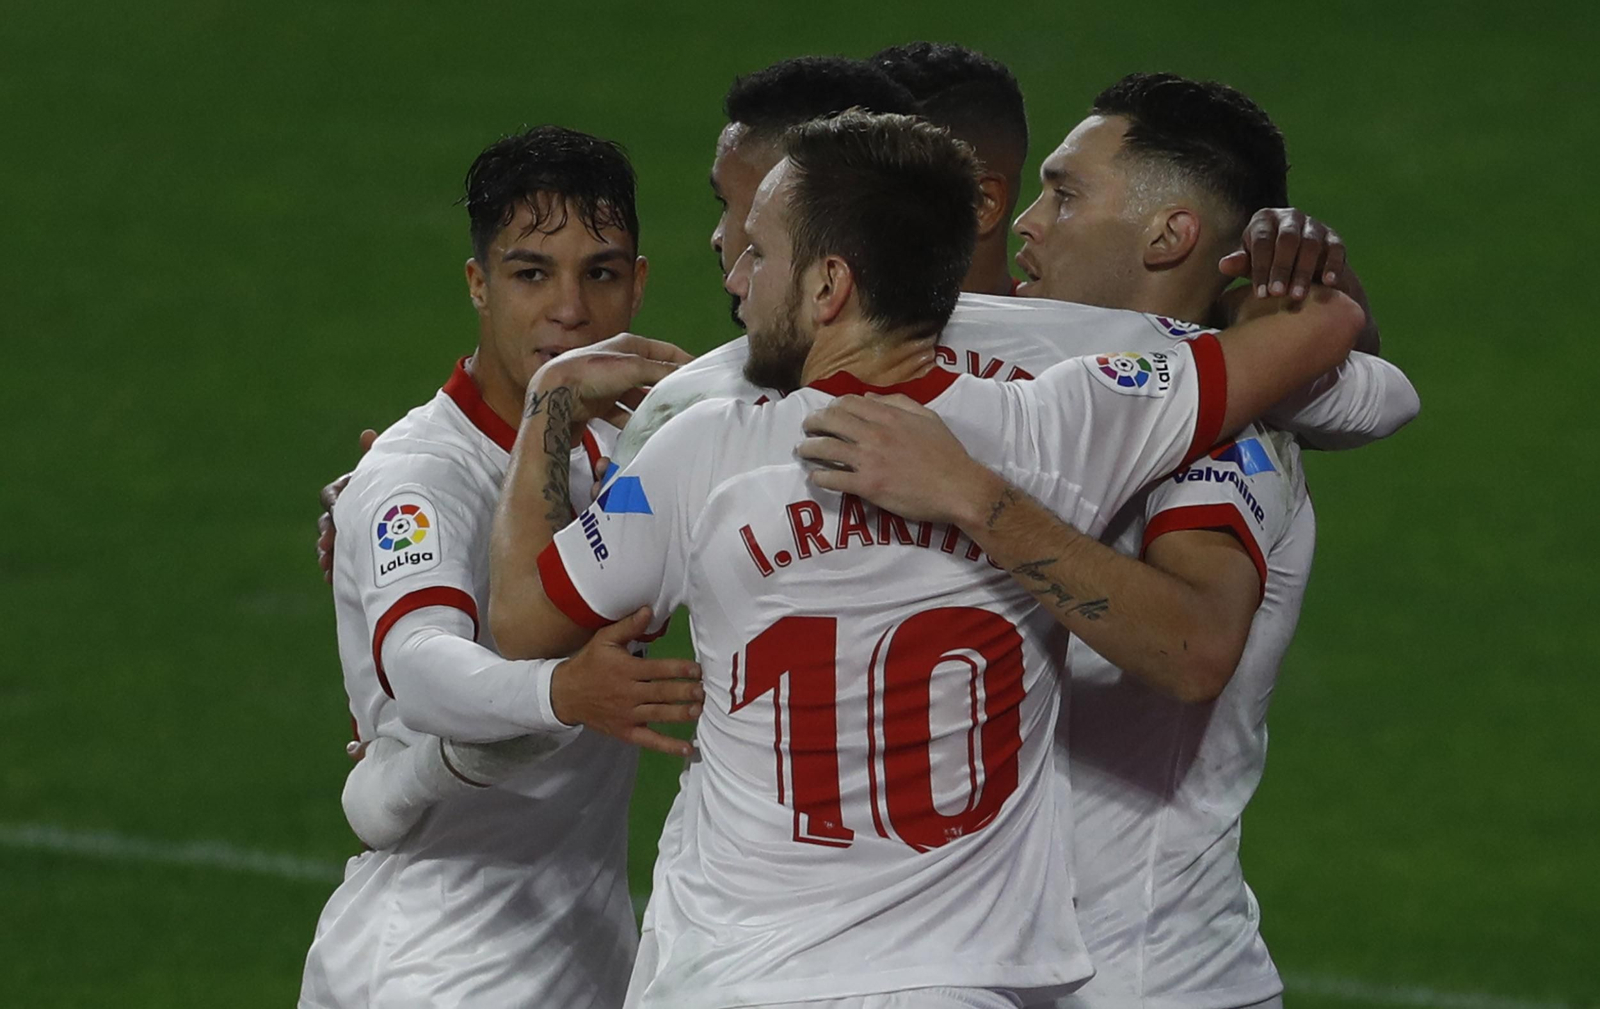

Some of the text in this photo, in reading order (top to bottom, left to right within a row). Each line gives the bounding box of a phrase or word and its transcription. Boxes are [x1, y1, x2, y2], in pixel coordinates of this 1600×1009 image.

[1149, 352, 1170, 390] LaLig
[380, 552, 433, 576] LaLiga
[739, 493, 1006, 577] I.RAK
[728, 606, 1026, 853] 10
